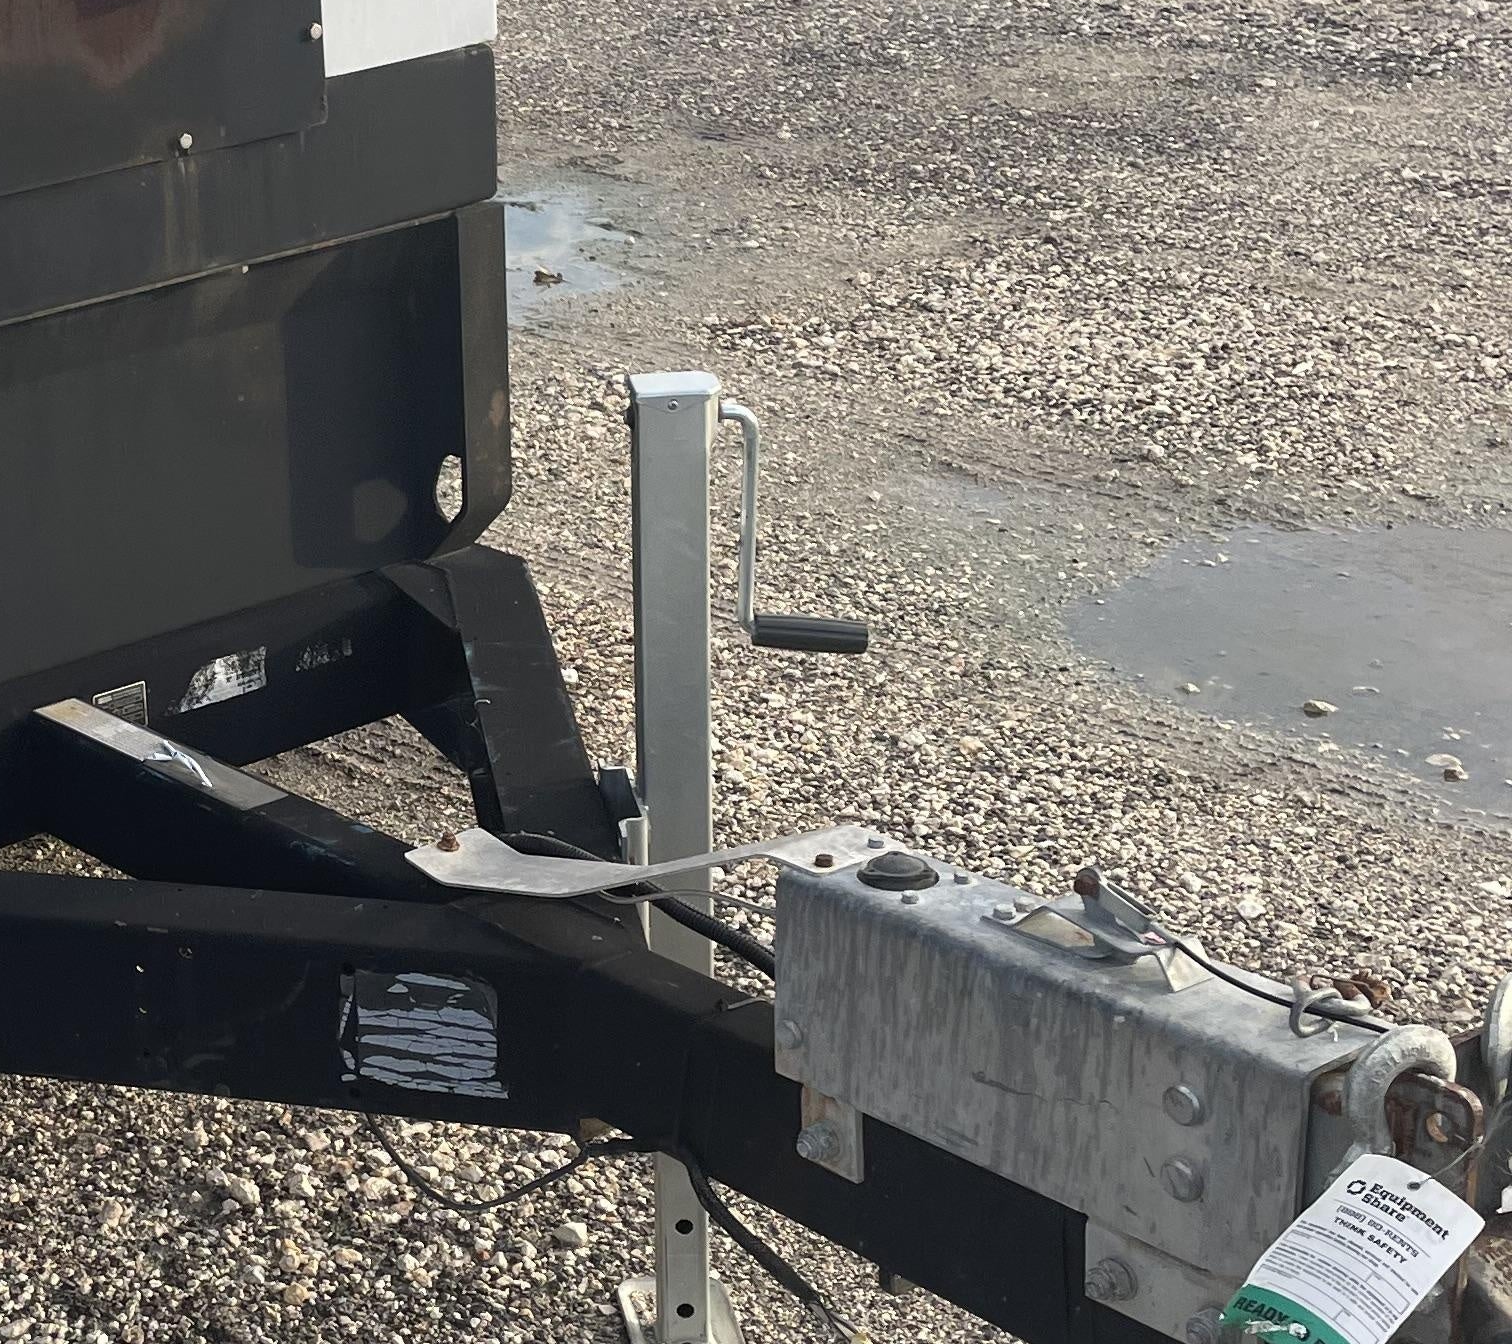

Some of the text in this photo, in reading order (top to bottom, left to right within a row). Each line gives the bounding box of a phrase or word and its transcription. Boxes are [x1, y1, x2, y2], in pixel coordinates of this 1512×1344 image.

[1361, 1194, 1406, 1223] Share
[1370, 1183, 1449, 1240] Equipment
[1334, 1216, 1407, 1264] THINK SAFETY
